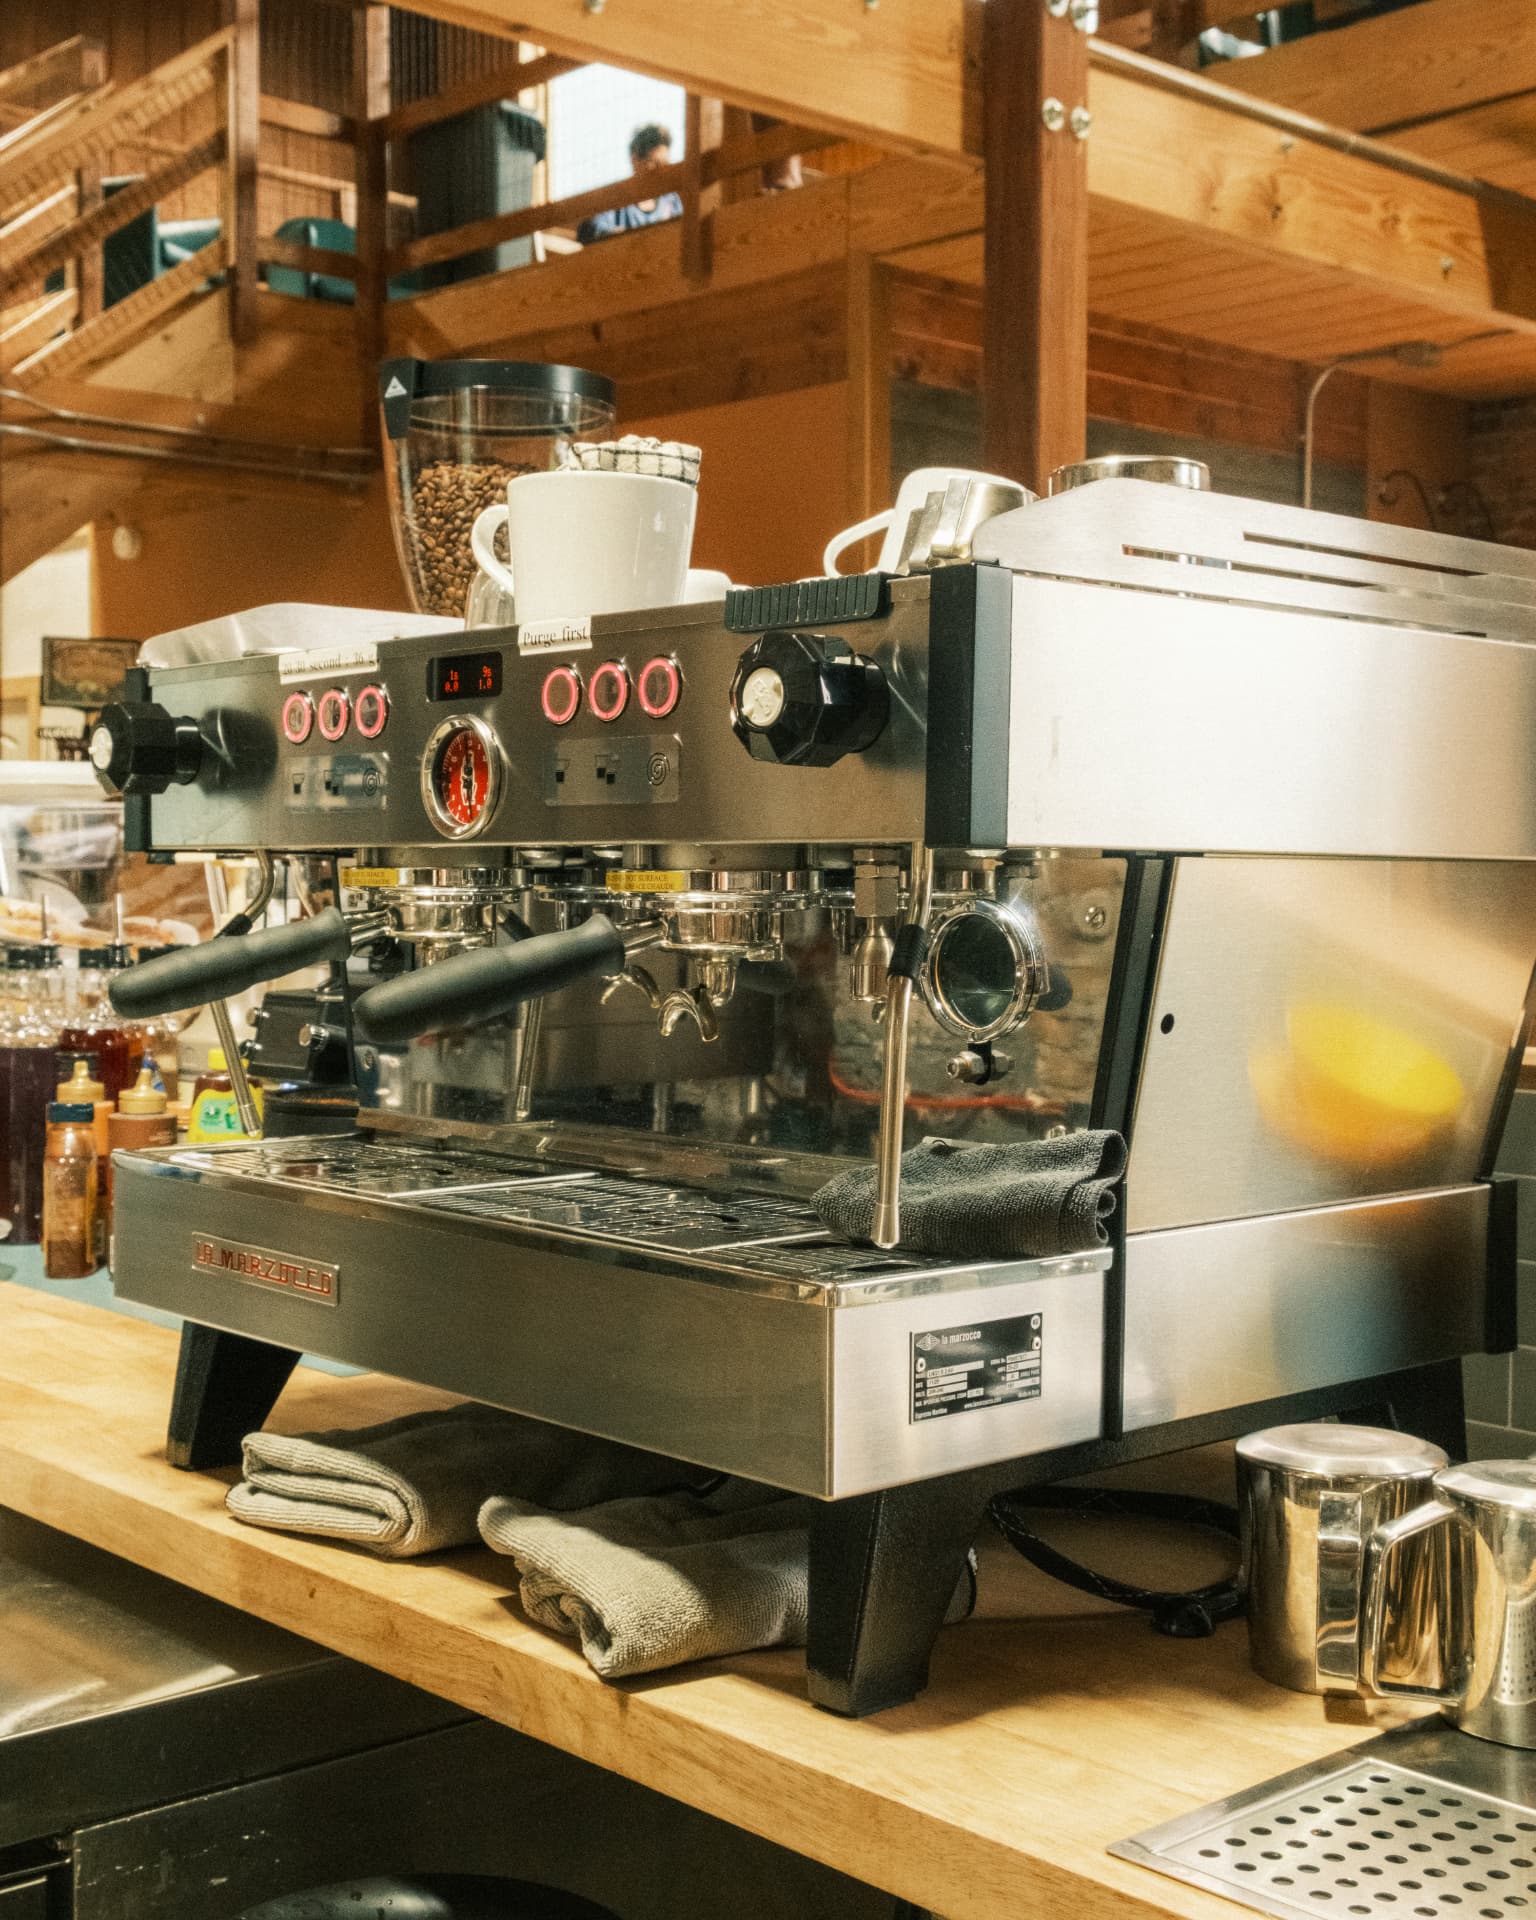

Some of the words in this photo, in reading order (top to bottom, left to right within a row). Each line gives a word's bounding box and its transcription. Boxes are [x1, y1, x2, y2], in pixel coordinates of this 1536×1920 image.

[523, 631, 556, 648] Purge
[562, 625, 588, 641] first
[195, 1241, 215, 1265] LA
[219, 1247, 332, 1296] MARZOCCO
[941, 1335, 948, 1345] la
[949, 1330, 982, 1345] marzocco
